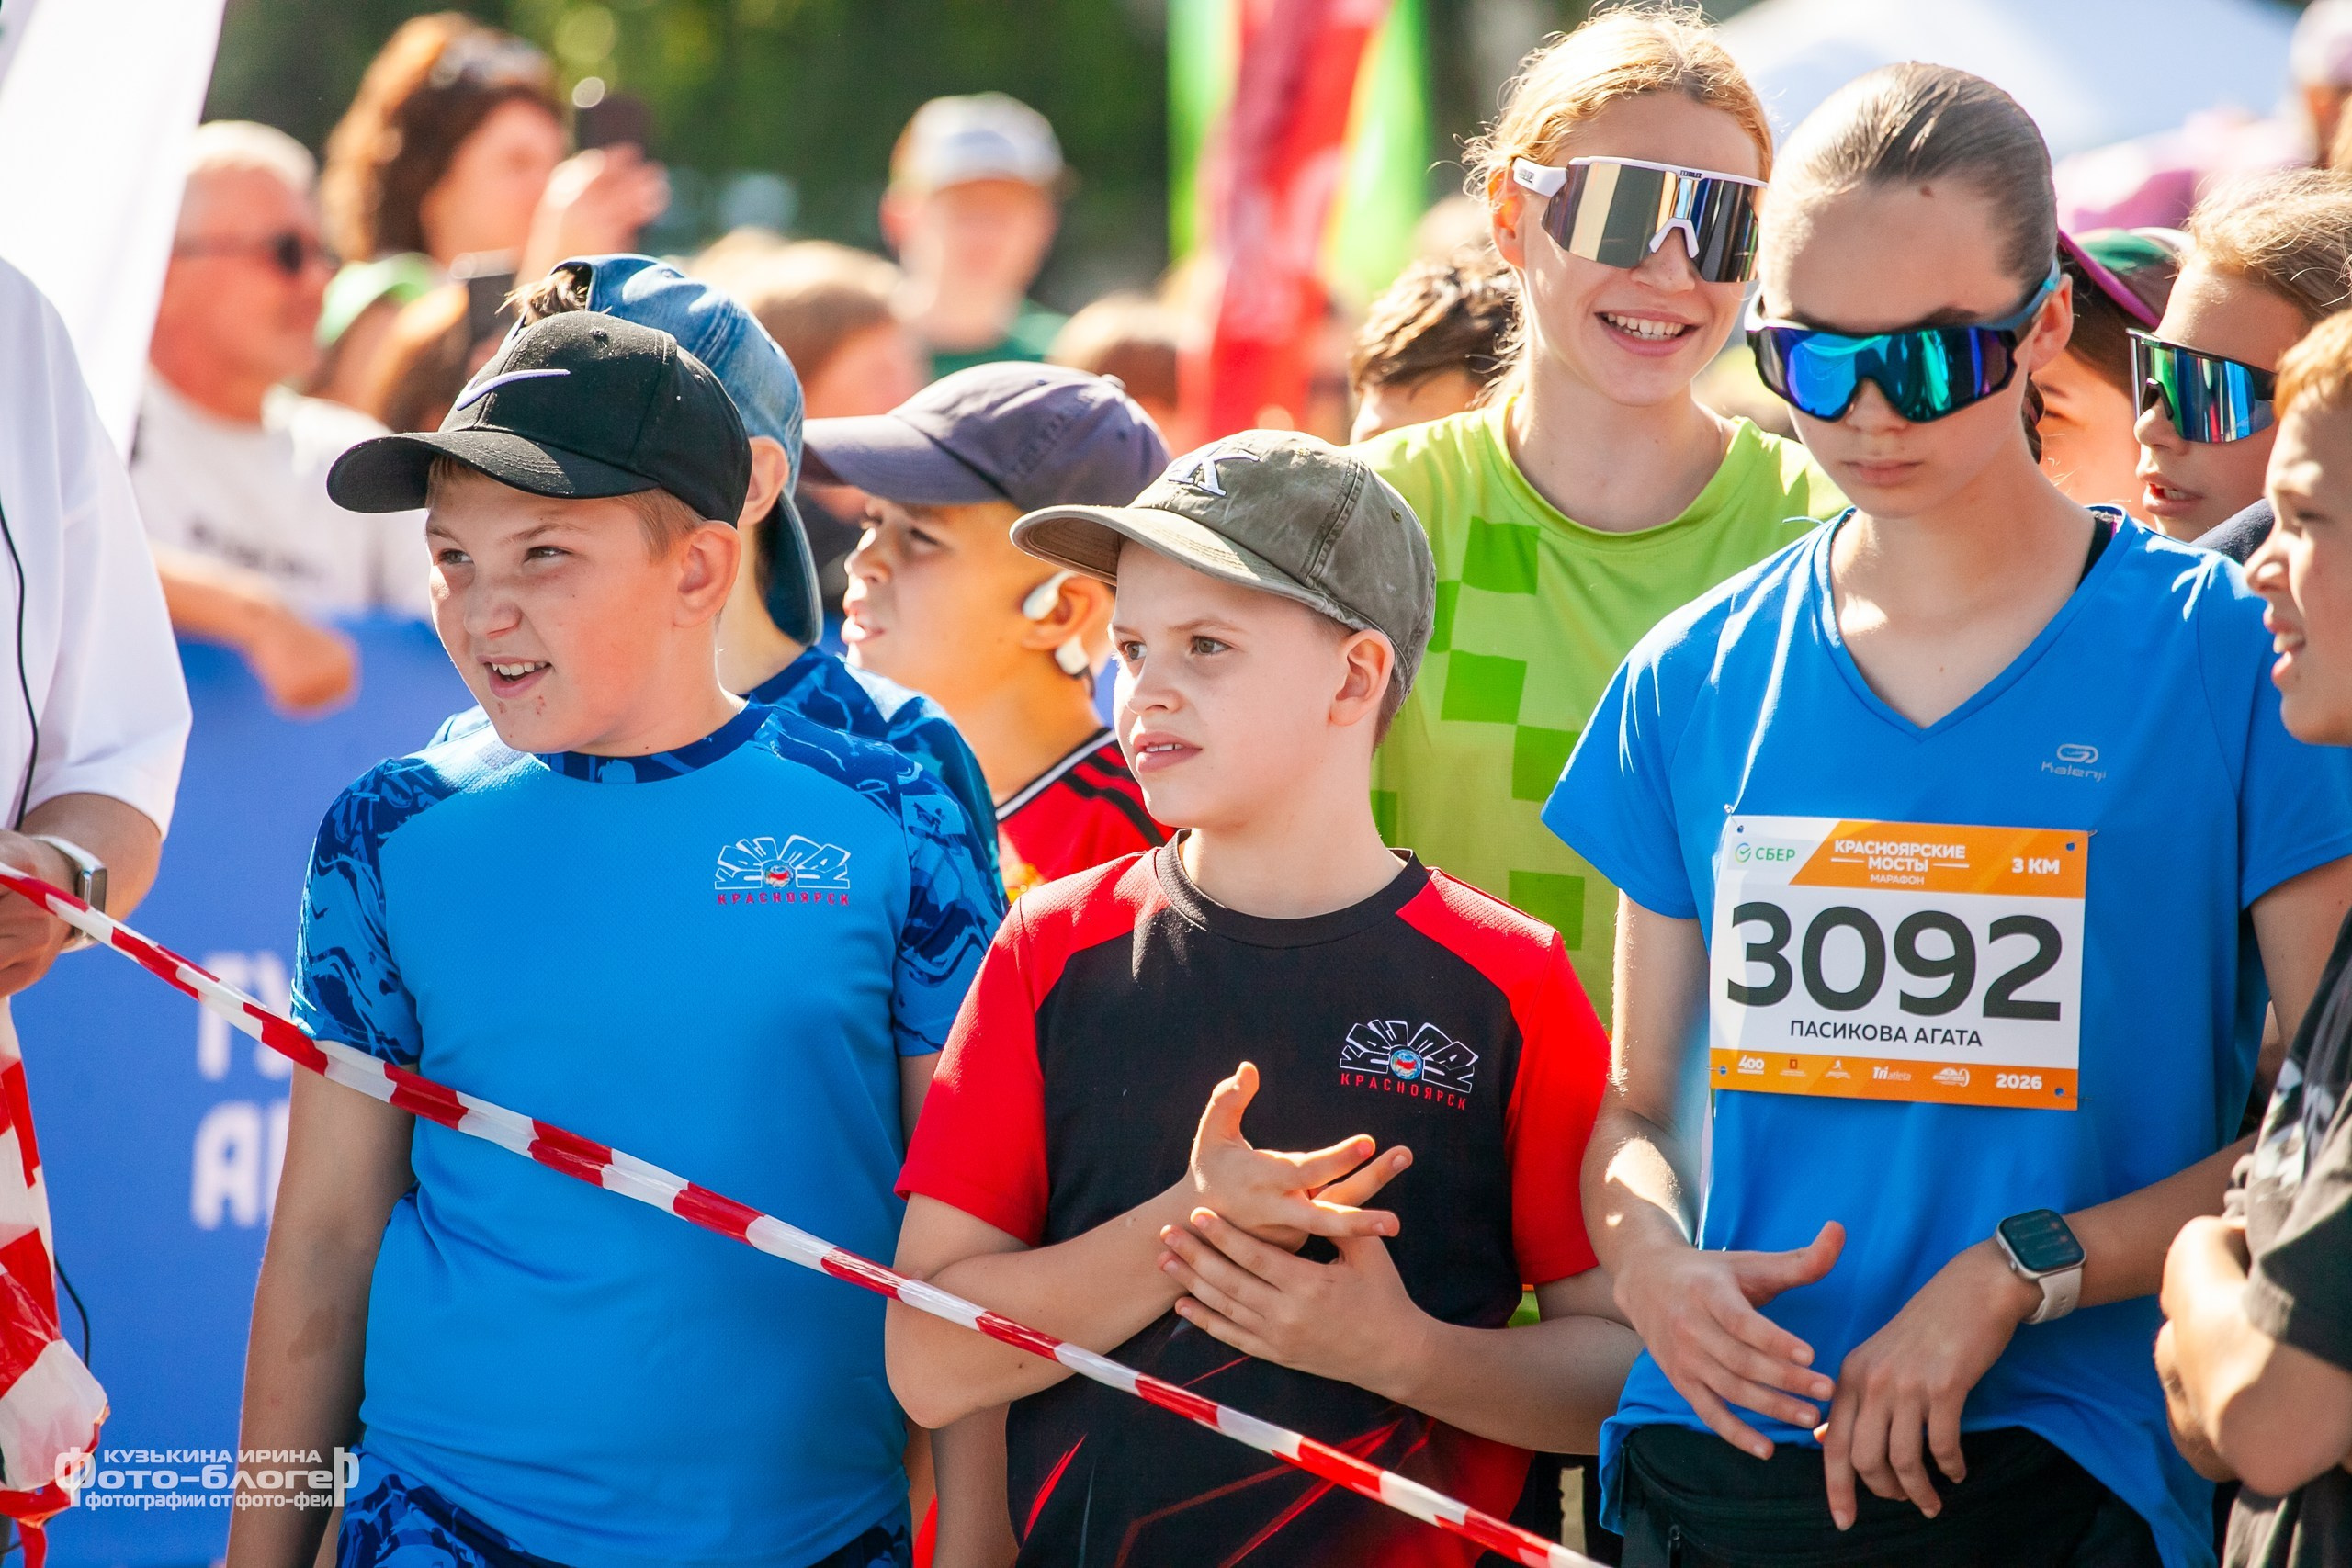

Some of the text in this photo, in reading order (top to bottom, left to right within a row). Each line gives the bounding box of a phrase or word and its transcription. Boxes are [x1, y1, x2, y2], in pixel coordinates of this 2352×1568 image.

[1755, 846, 1796, 862] СБЕР
[1834, 839, 1966, 860] КРАСНОЯРСКИЕ
[1868, 854, 1928, 873] МОСТЫ
[2011, 857, 2061, 875] 3 КМ
[1870, 873, 1925, 886] МАРАФОН
[718, 892, 850, 906] КРАСНОЯРСК
[1727, 901, 2063, 1021] 3092
[1790, 1019, 1984, 1047] ПАСИКОВА АГАТА
[1996, 1073, 2043, 1090] 2026
[1340, 1072, 1467, 1111] КРАСНОЯРСК
